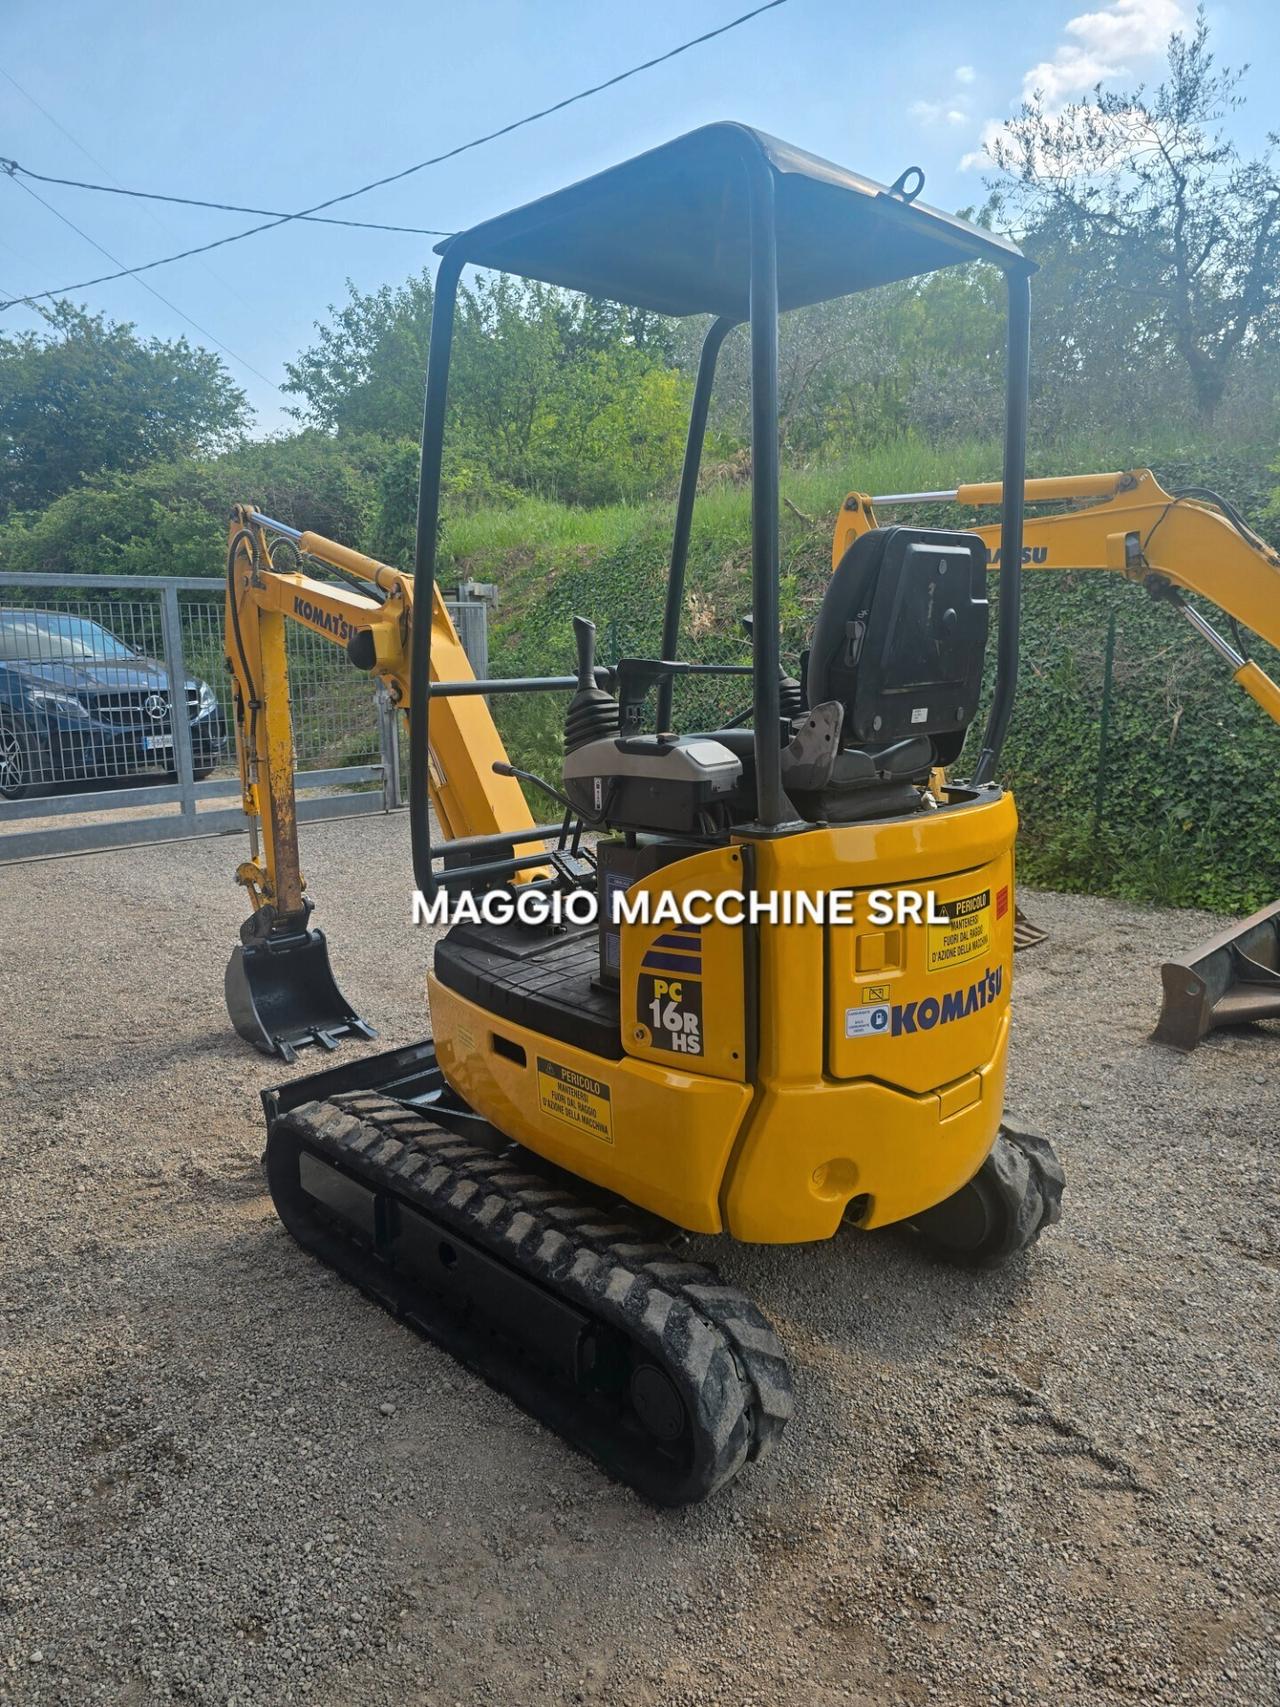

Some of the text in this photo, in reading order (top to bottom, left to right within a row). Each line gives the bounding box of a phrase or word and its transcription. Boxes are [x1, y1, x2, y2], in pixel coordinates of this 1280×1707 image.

[956, 893, 987, 915] PERICOLO
[943, 933, 959, 947] FUORI
[959, 931, 969, 942] DAL
[932, 947, 957, 963] D'AZIONE
[957, 941, 972, 956] DELLA
[653, 979, 683, 1003] PC
[891, 964, 1003, 1038] KOMATSU
[648, 999, 700, 1035] 16R
[671, 1032, 701, 1054] HS
[561, 1068, 601, 1096] PERICOLO
[542, 1097, 565, 1115] D'AZIONE
[565, 1107, 580, 1121] DELLA
[551, 1090, 566, 1103] FUORI
[566, 1097, 577, 1109] DAL
